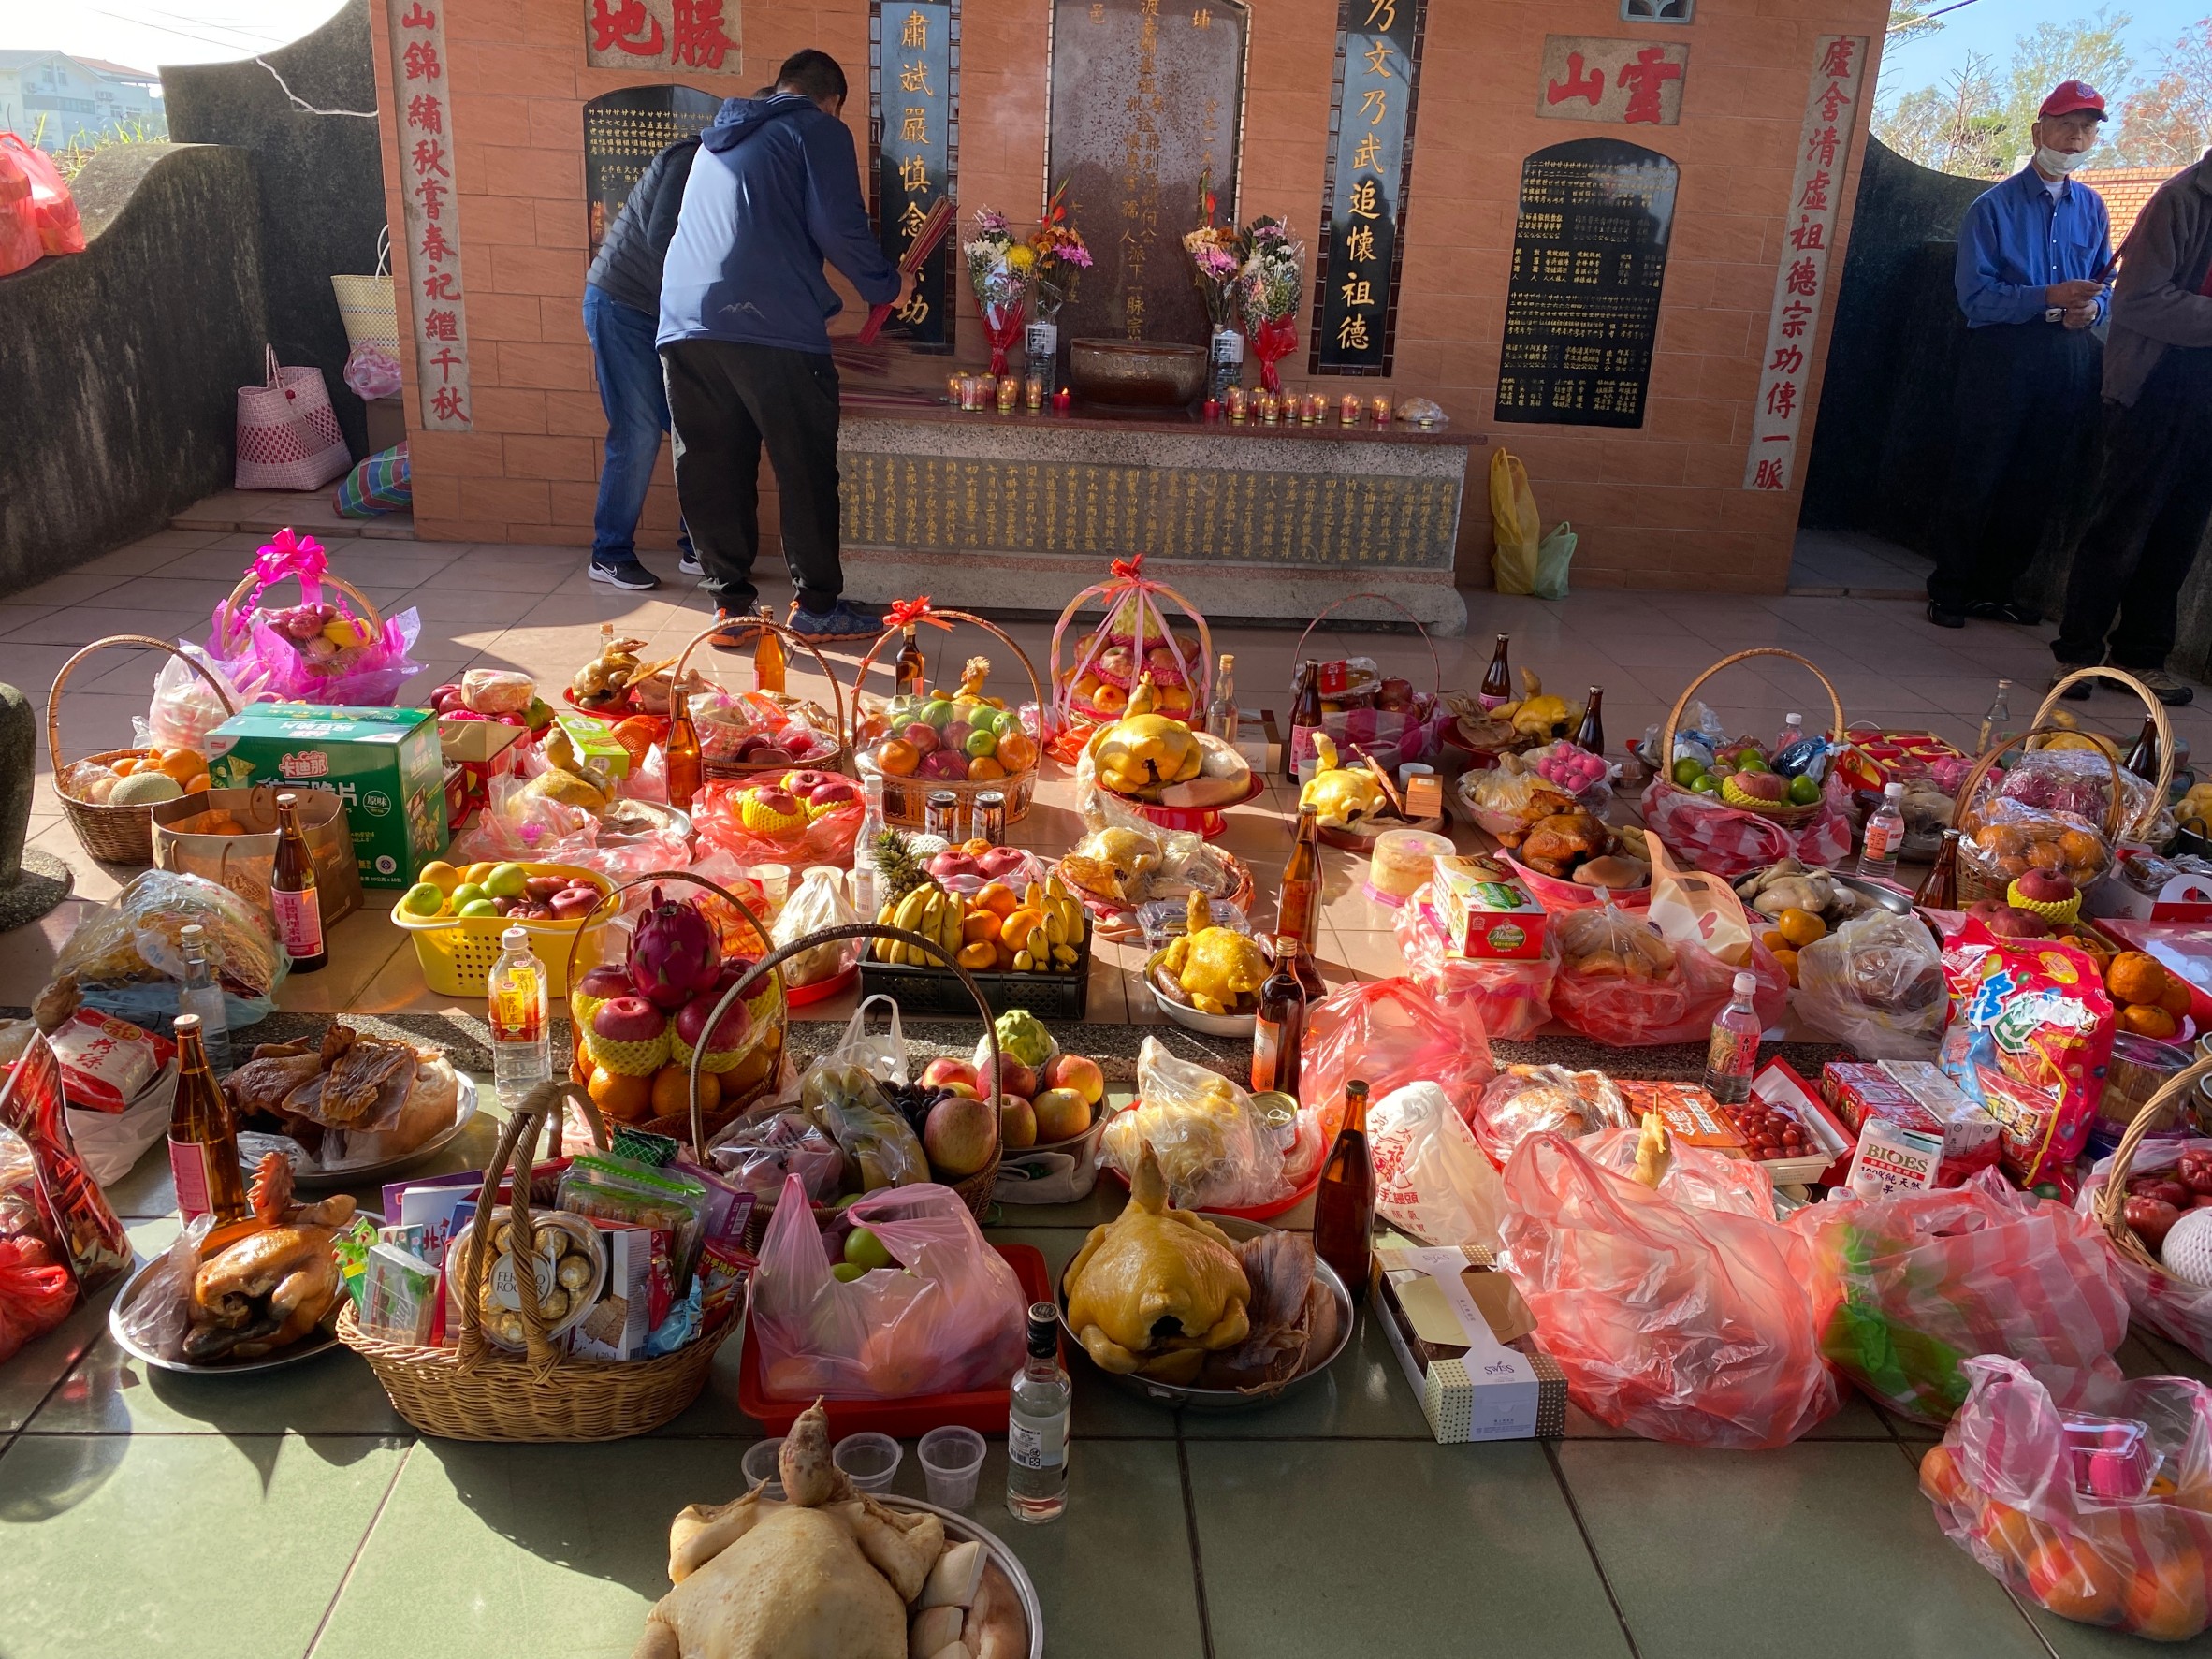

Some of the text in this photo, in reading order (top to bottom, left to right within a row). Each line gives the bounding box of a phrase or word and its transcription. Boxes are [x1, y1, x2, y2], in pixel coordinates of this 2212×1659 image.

[896, 9, 934, 326] 肅斌嚴慎念功
[1337, 0, 1395, 350] 乃文乃武追懷祖德
[280, 759, 327, 778] 卡迪那
[367, 795, 387, 808] 原味
[76, 1037, 119, 1070] 粉絲
[1865, 1143, 1928, 1173] BIOES
[1376, 1185, 1420, 1205] 手工饅頭
[498, 1271, 546, 1285] FERO
[497, 1282, 544, 1296] ROCR
[1484, 1363, 1515, 1375] SWISS
